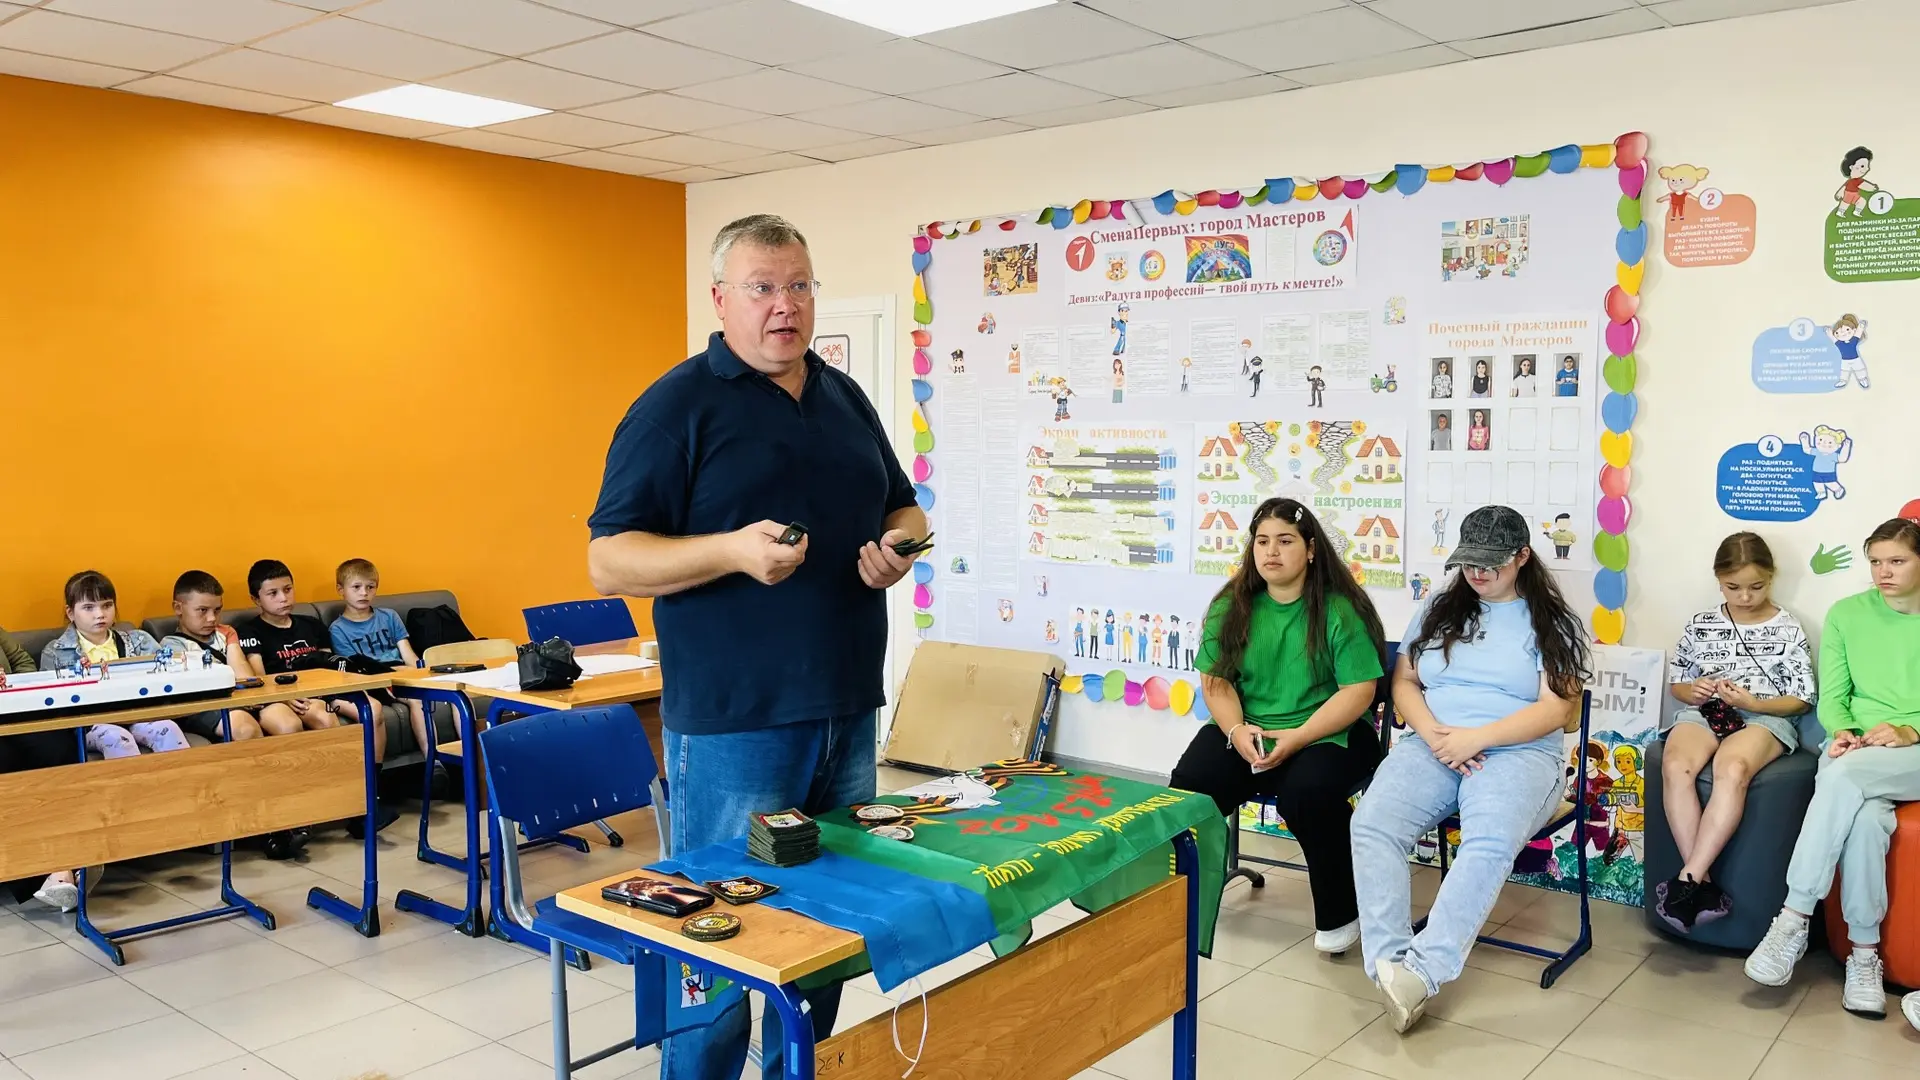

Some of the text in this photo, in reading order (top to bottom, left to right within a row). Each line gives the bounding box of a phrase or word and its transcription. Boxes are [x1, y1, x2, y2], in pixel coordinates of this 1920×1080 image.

[1707, 193, 1715, 205] 2
[1200, 217, 1243, 234] город
[1247, 210, 1325, 229] Мастеров
[1219, 281, 1248, 294] твой
[1250, 282, 1278, 294] путь
[1428, 321, 1500, 335] Почетный
[1797, 324, 1805, 336] 3
[1448, 335, 1573, 352] города Мастеров
[1089, 429, 1168, 439] активности
[1766, 441, 1774, 453] 4
[1210, 490, 1402, 511] Экран настроения
[352, 629, 395, 656] THE
